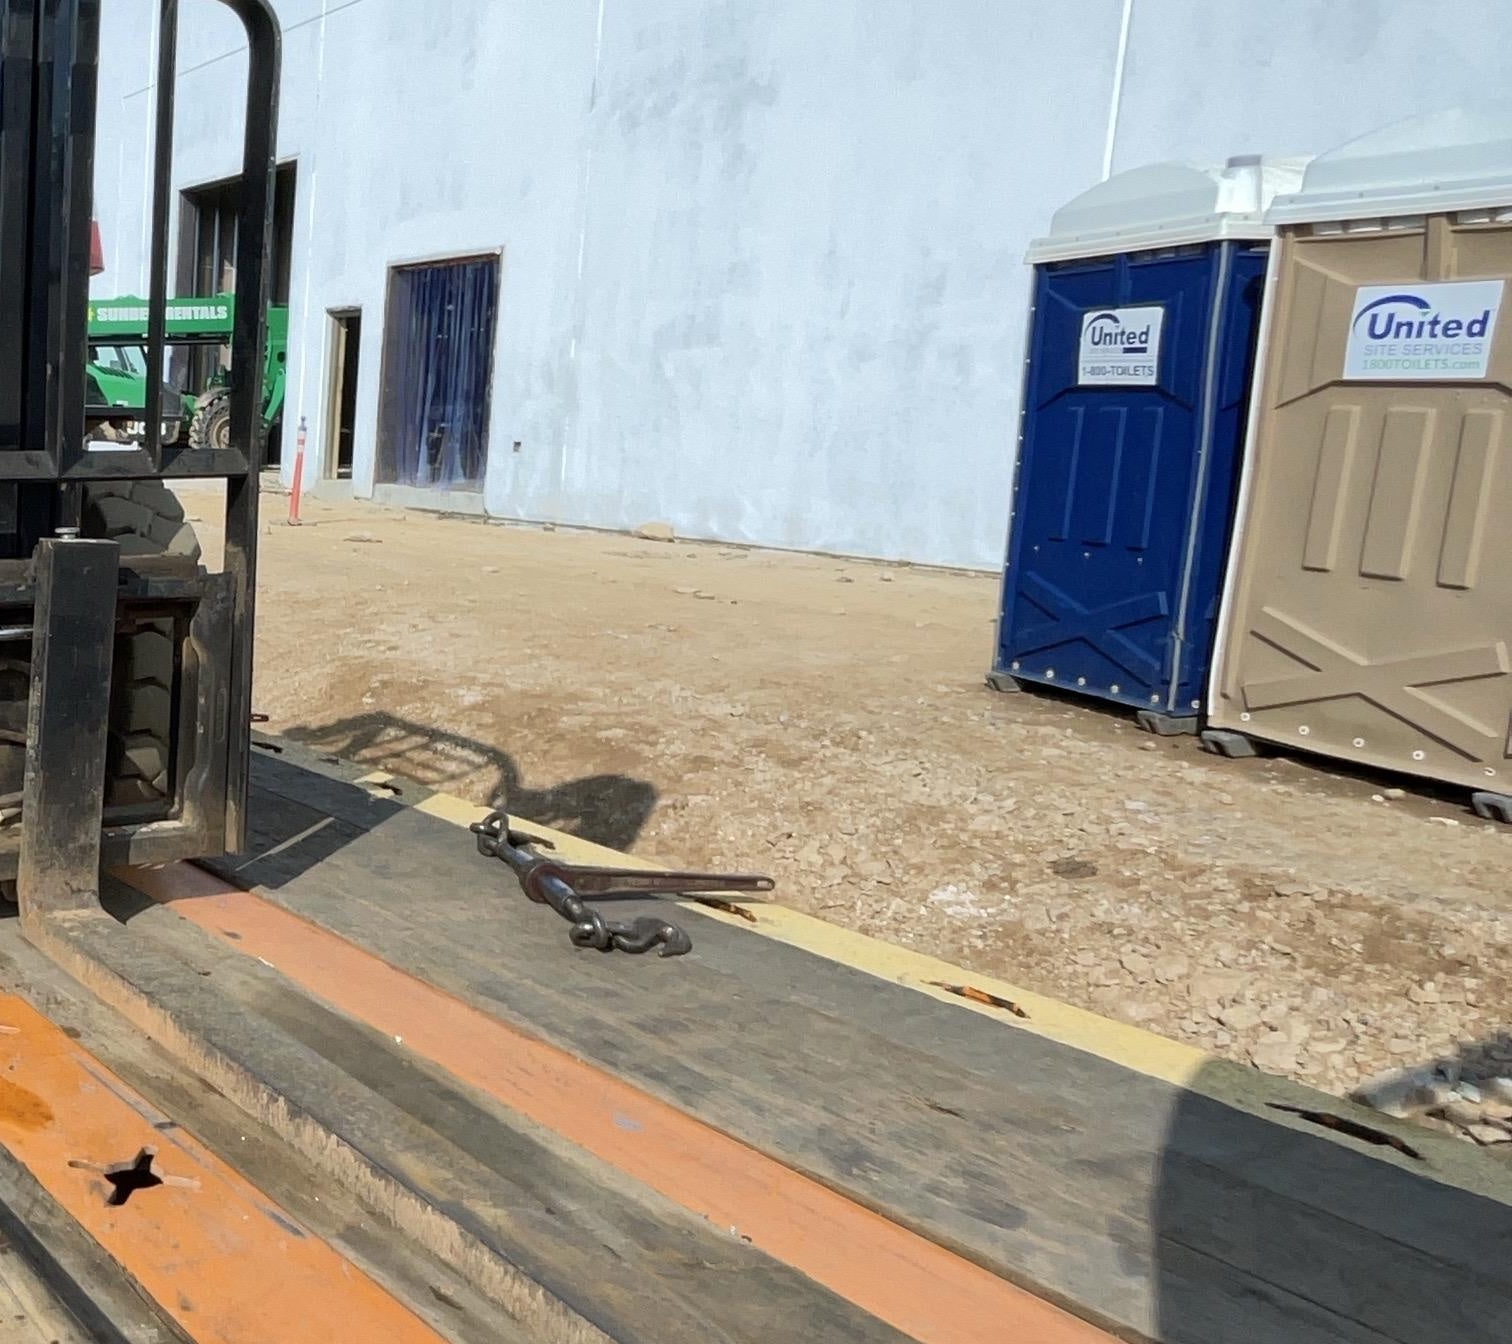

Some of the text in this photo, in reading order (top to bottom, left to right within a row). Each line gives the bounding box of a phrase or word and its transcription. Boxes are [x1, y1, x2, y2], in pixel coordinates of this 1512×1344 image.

[1367, 309, 1491, 340] United
[1091, 323, 1150, 346] United
[1363, 342, 1483, 356] SITE SERVICES
[1082, 365, 1154, 377] 1-800-TOILETS
